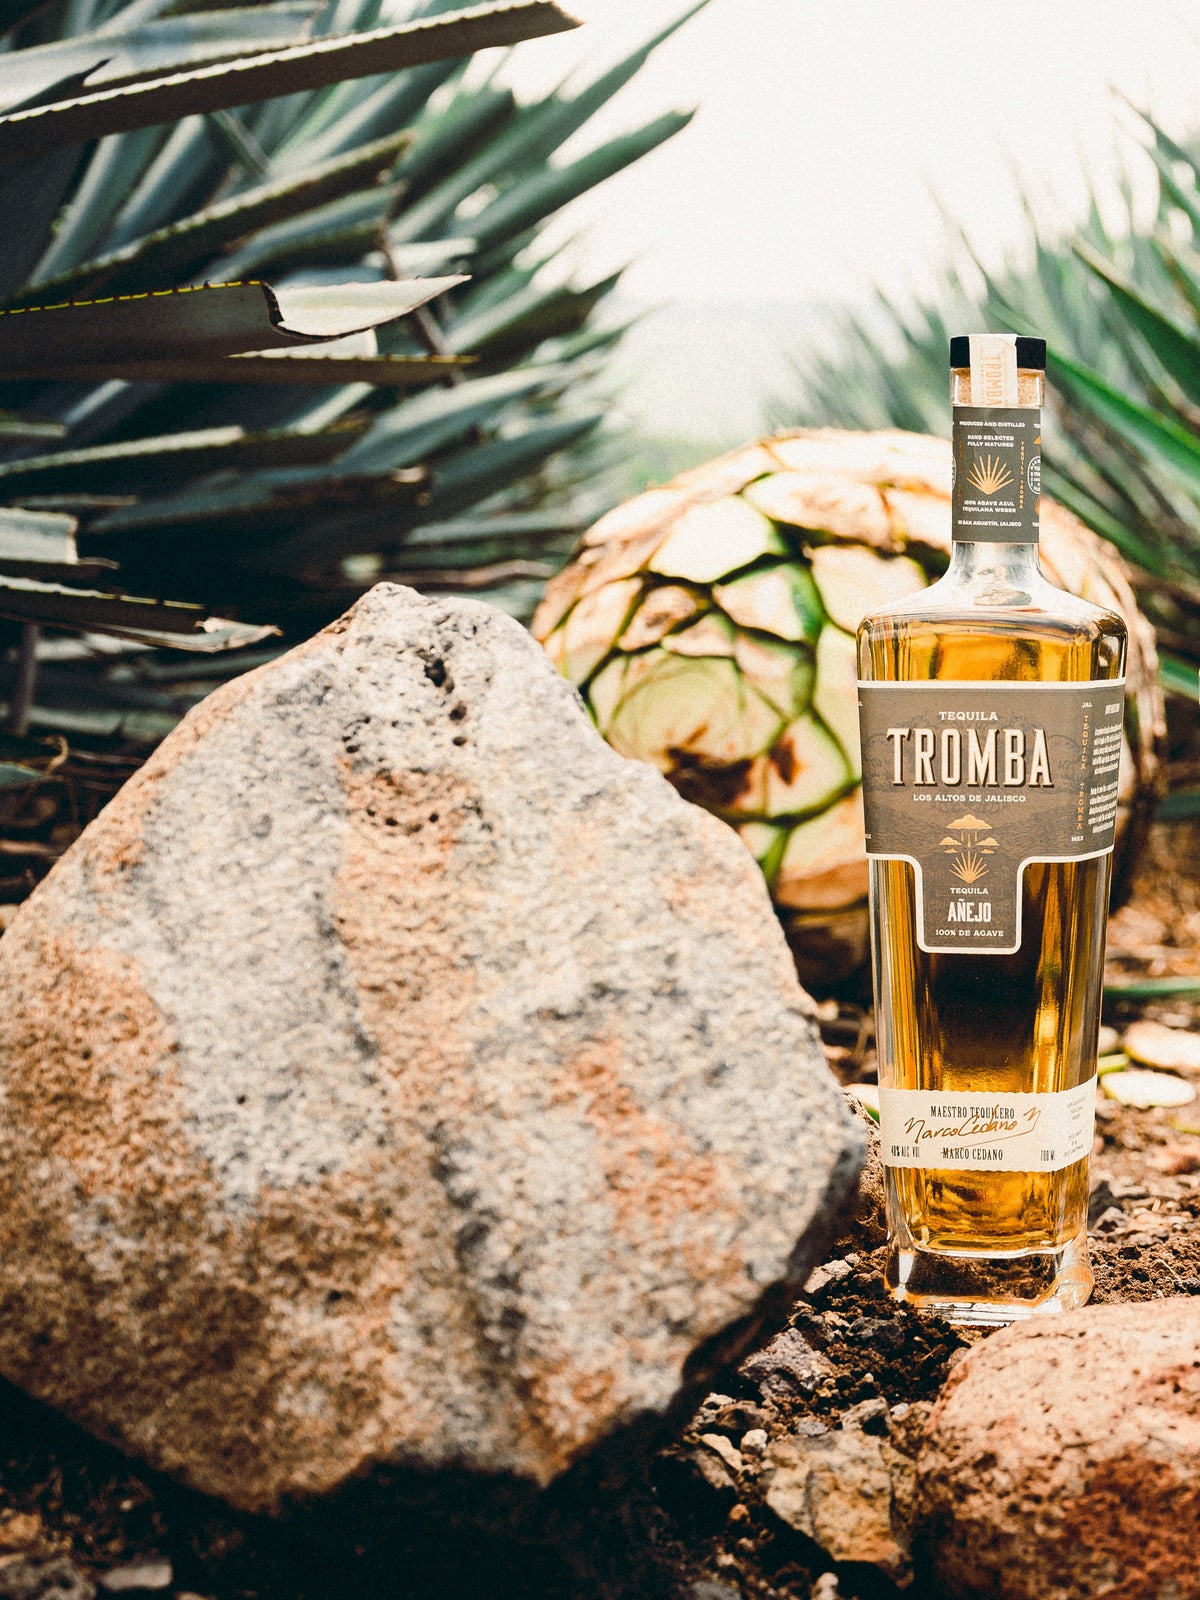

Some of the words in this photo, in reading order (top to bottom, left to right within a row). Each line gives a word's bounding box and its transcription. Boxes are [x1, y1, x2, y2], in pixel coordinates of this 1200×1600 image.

[938, 711, 999, 721] TEQUILA
[1080, 714, 1089, 770] TEQUILA
[886, 727, 1054, 788] TROMBA
[913, 793, 933, 801] LOS
[934, 794, 966, 802] ALTOS
[968, 794, 982, 802] DE
[984, 794, 1026, 803] JALISCO
[1076, 783, 1085, 830] TROMBA
[950, 887, 989, 895] TEQUILA
[947, 898, 992, 923] AÑEJO
[958, 929, 971, 937] DE
[930, 1106, 968, 1118] MAESTRO
[969, 1106, 1015, 1120] TEQUILERO
[942, 1147, 969, 1159] MARCO
[972, 1148, 1003, 1161] CEDANO
